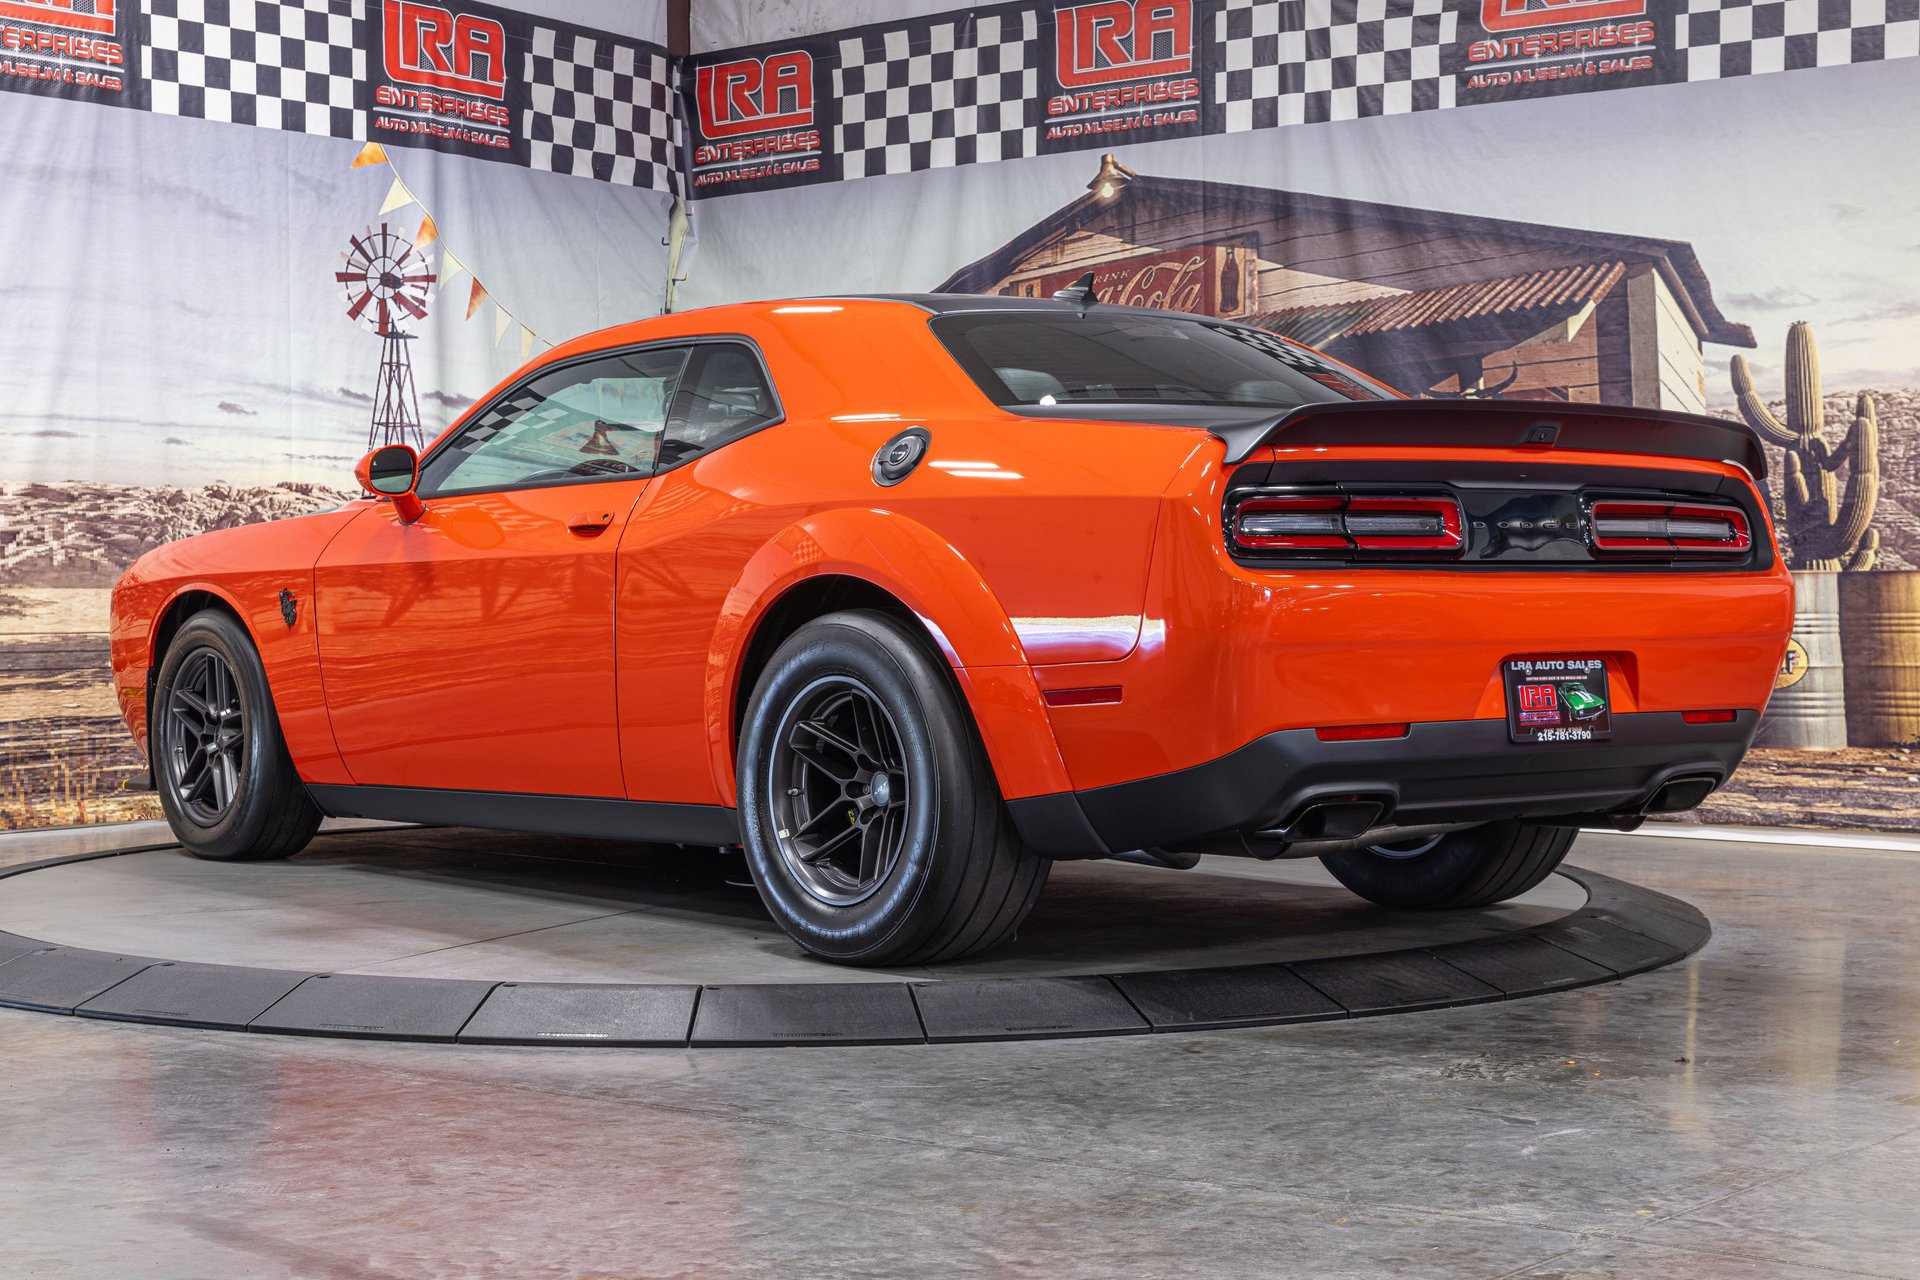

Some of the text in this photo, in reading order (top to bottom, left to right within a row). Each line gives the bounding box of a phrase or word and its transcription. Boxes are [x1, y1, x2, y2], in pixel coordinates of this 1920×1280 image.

[0, 24, 124, 64] ERPRISES
[382, 0, 507, 101] LRA
[1055, 0, 1193, 89] LRA
[1468, 20, 1656, 62] ENTERPRISES
[63, 68, 74, 84] &
[75, 71, 123, 91] SALES
[1467, 55, 1654, 90] AUTO MUSEUM & SALES
[375, 85, 511, 126] ENTERPRISES
[695, 49, 814, 140] LRA
[1047, 78, 1199, 115] ENTERPRISES
[374, 116, 511, 149] AUTO MUSEUM & SALES
[1046, 109, 1198, 140] AUTO MUSEUM & SALES
[695, 130, 820, 164] ENTERPRISES
[694, 159, 820, 187] AUTO MUSEUM & SALES
[1094, 268, 1131, 285] RINK
[1472, 521, 1578, 530] DODGE
[1511, 660, 1602, 671] LRA AUTO SALES
[1519, 685, 1558, 711] LRA
[1537, 731, 1592, 741] 215-781-3790
